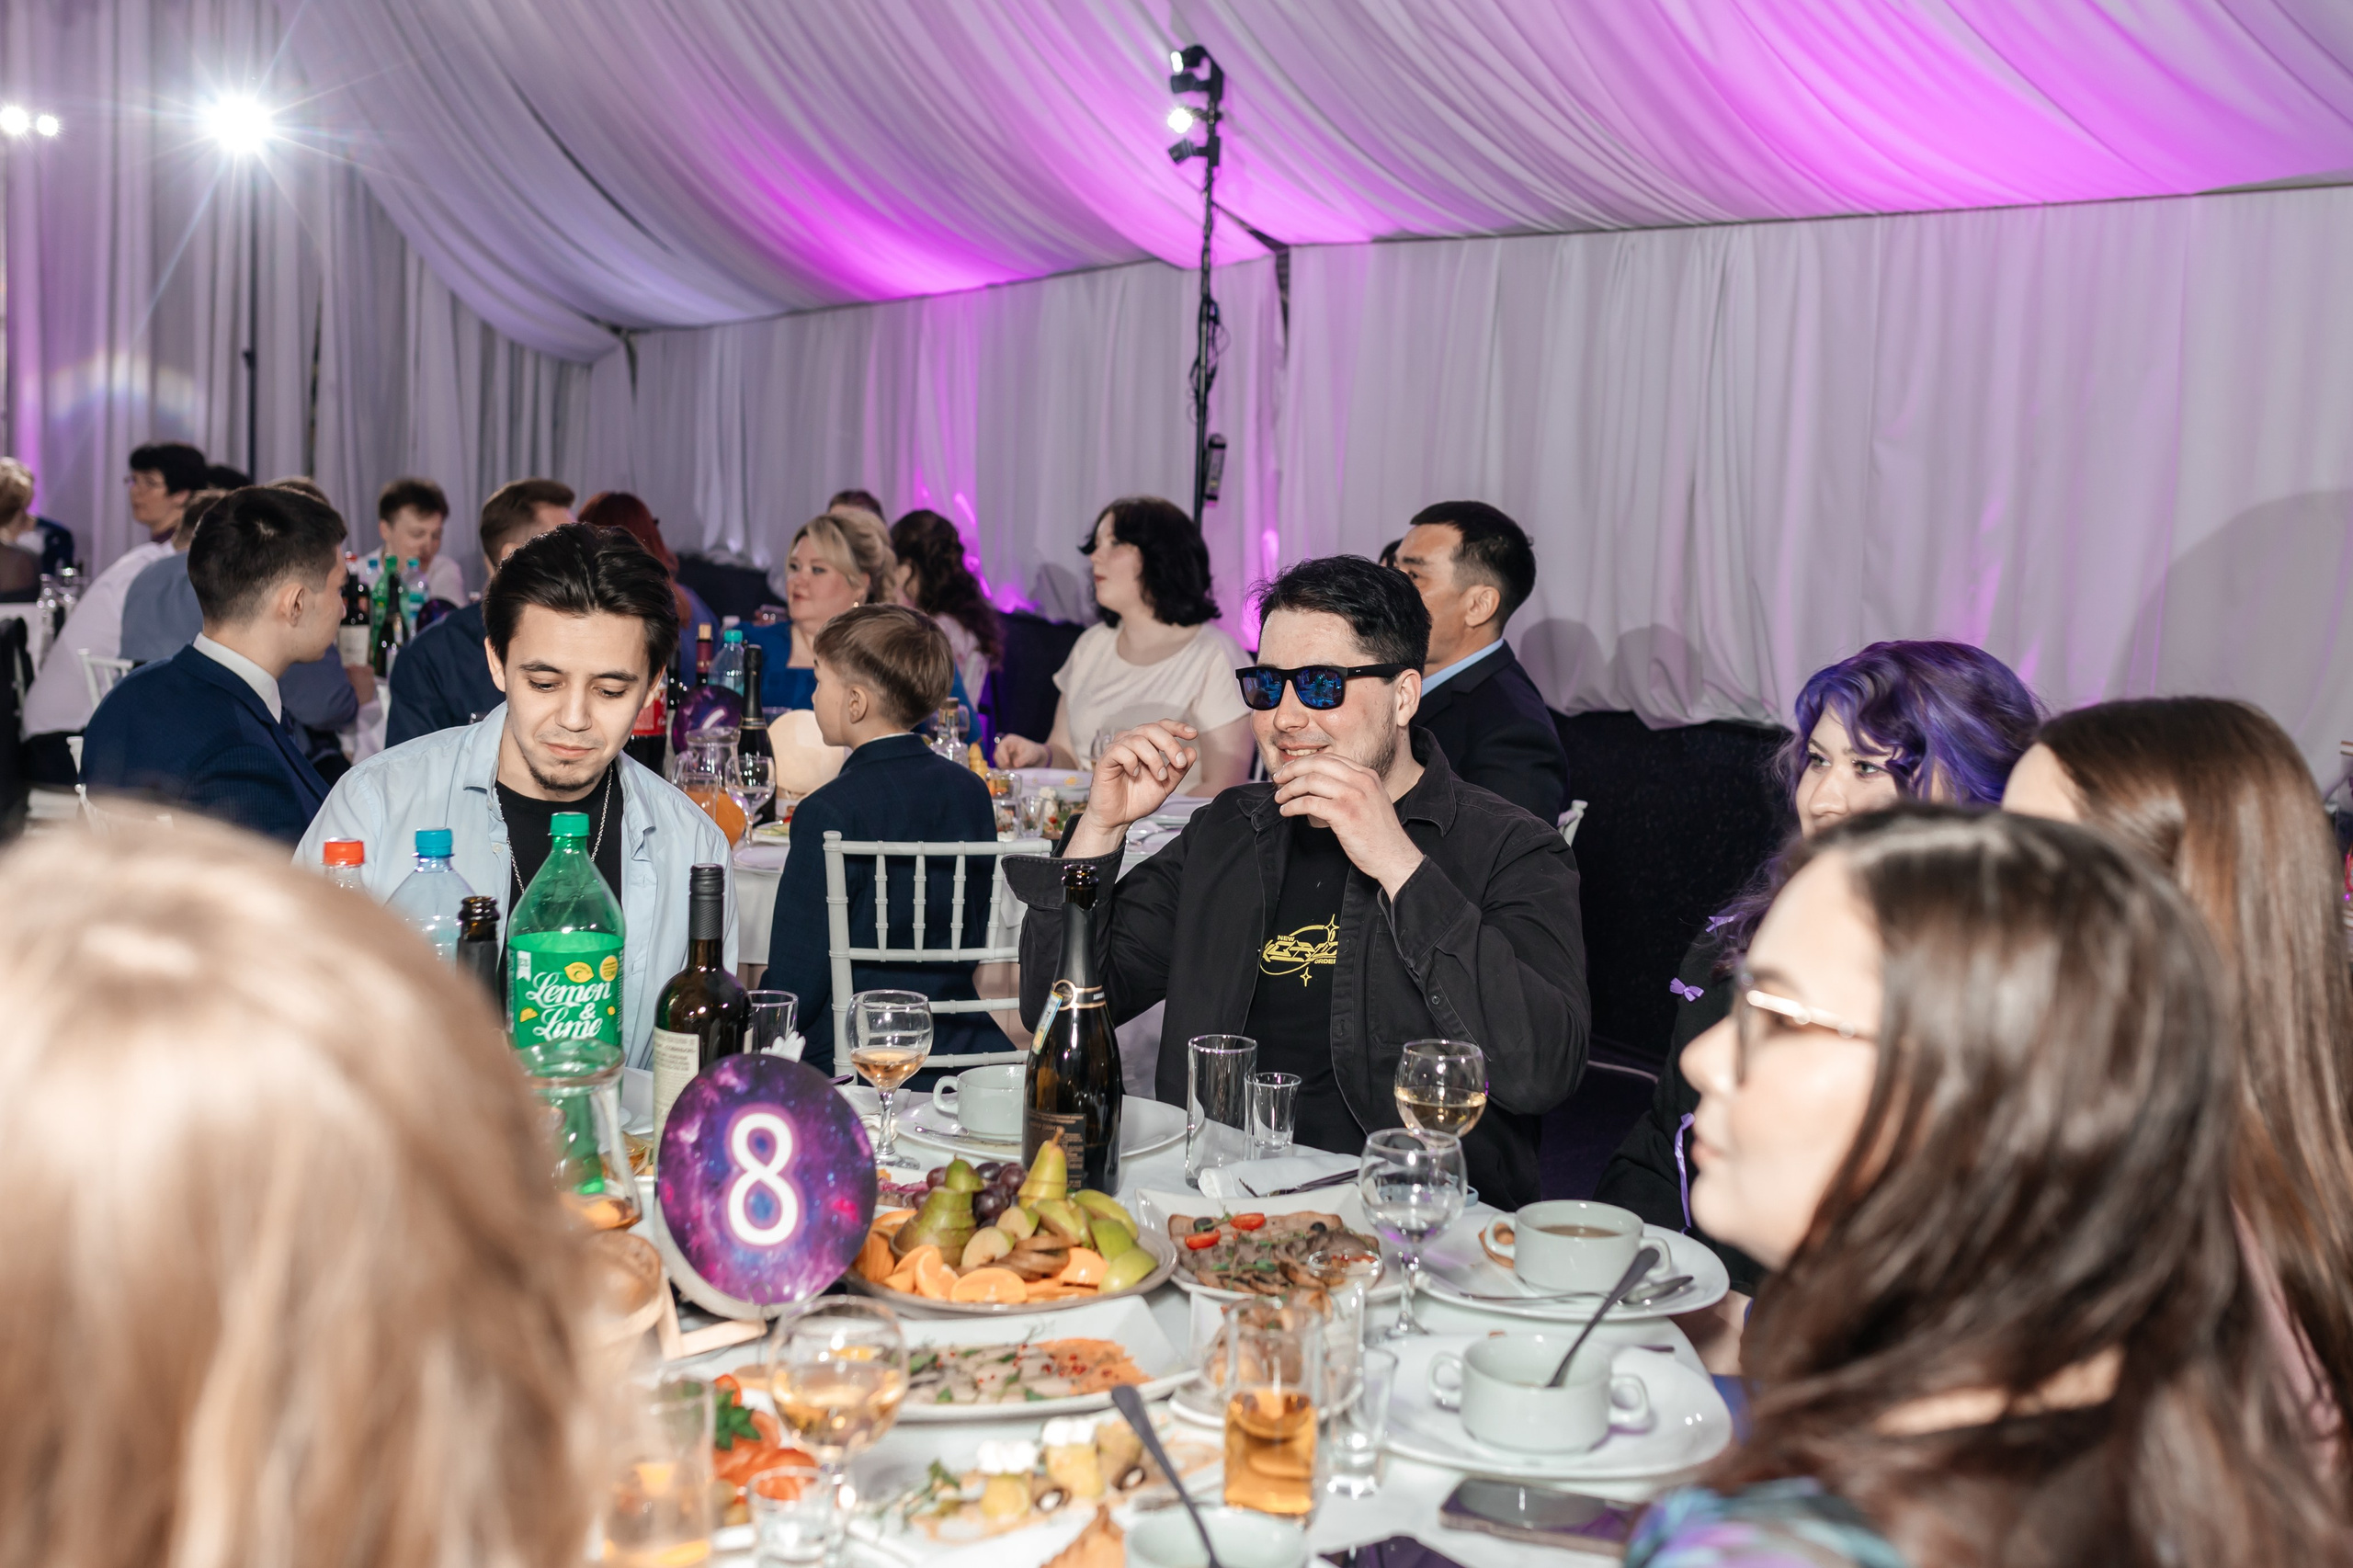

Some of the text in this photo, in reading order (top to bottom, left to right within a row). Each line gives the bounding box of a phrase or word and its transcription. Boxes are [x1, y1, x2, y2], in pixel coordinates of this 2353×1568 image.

[525, 971, 612, 1008] Lemon
[532, 1007, 603, 1041] Lime
[579, 1002, 597, 1021] &
[728, 1113, 798, 1246] 8
